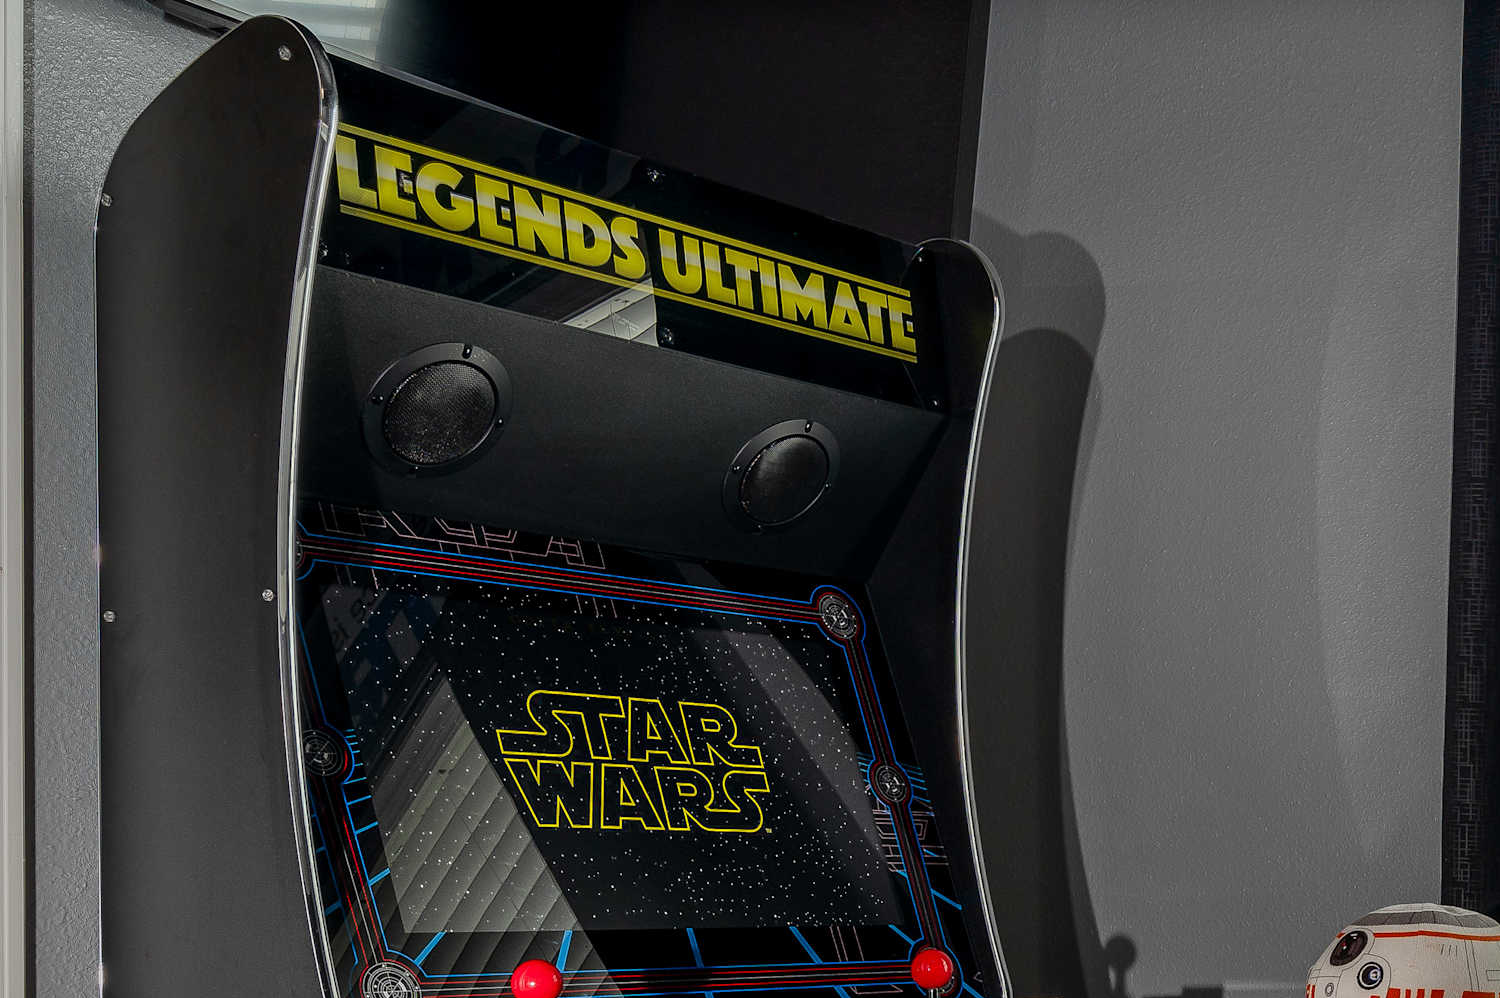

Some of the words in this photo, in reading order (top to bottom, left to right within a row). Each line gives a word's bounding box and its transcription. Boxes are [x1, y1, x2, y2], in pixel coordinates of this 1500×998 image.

[335, 136, 649, 280] LEGENDS
[658, 228, 918, 353] ULTIMATE
[496, 689, 765, 768] STAR
[504, 757, 770, 833] WARS
